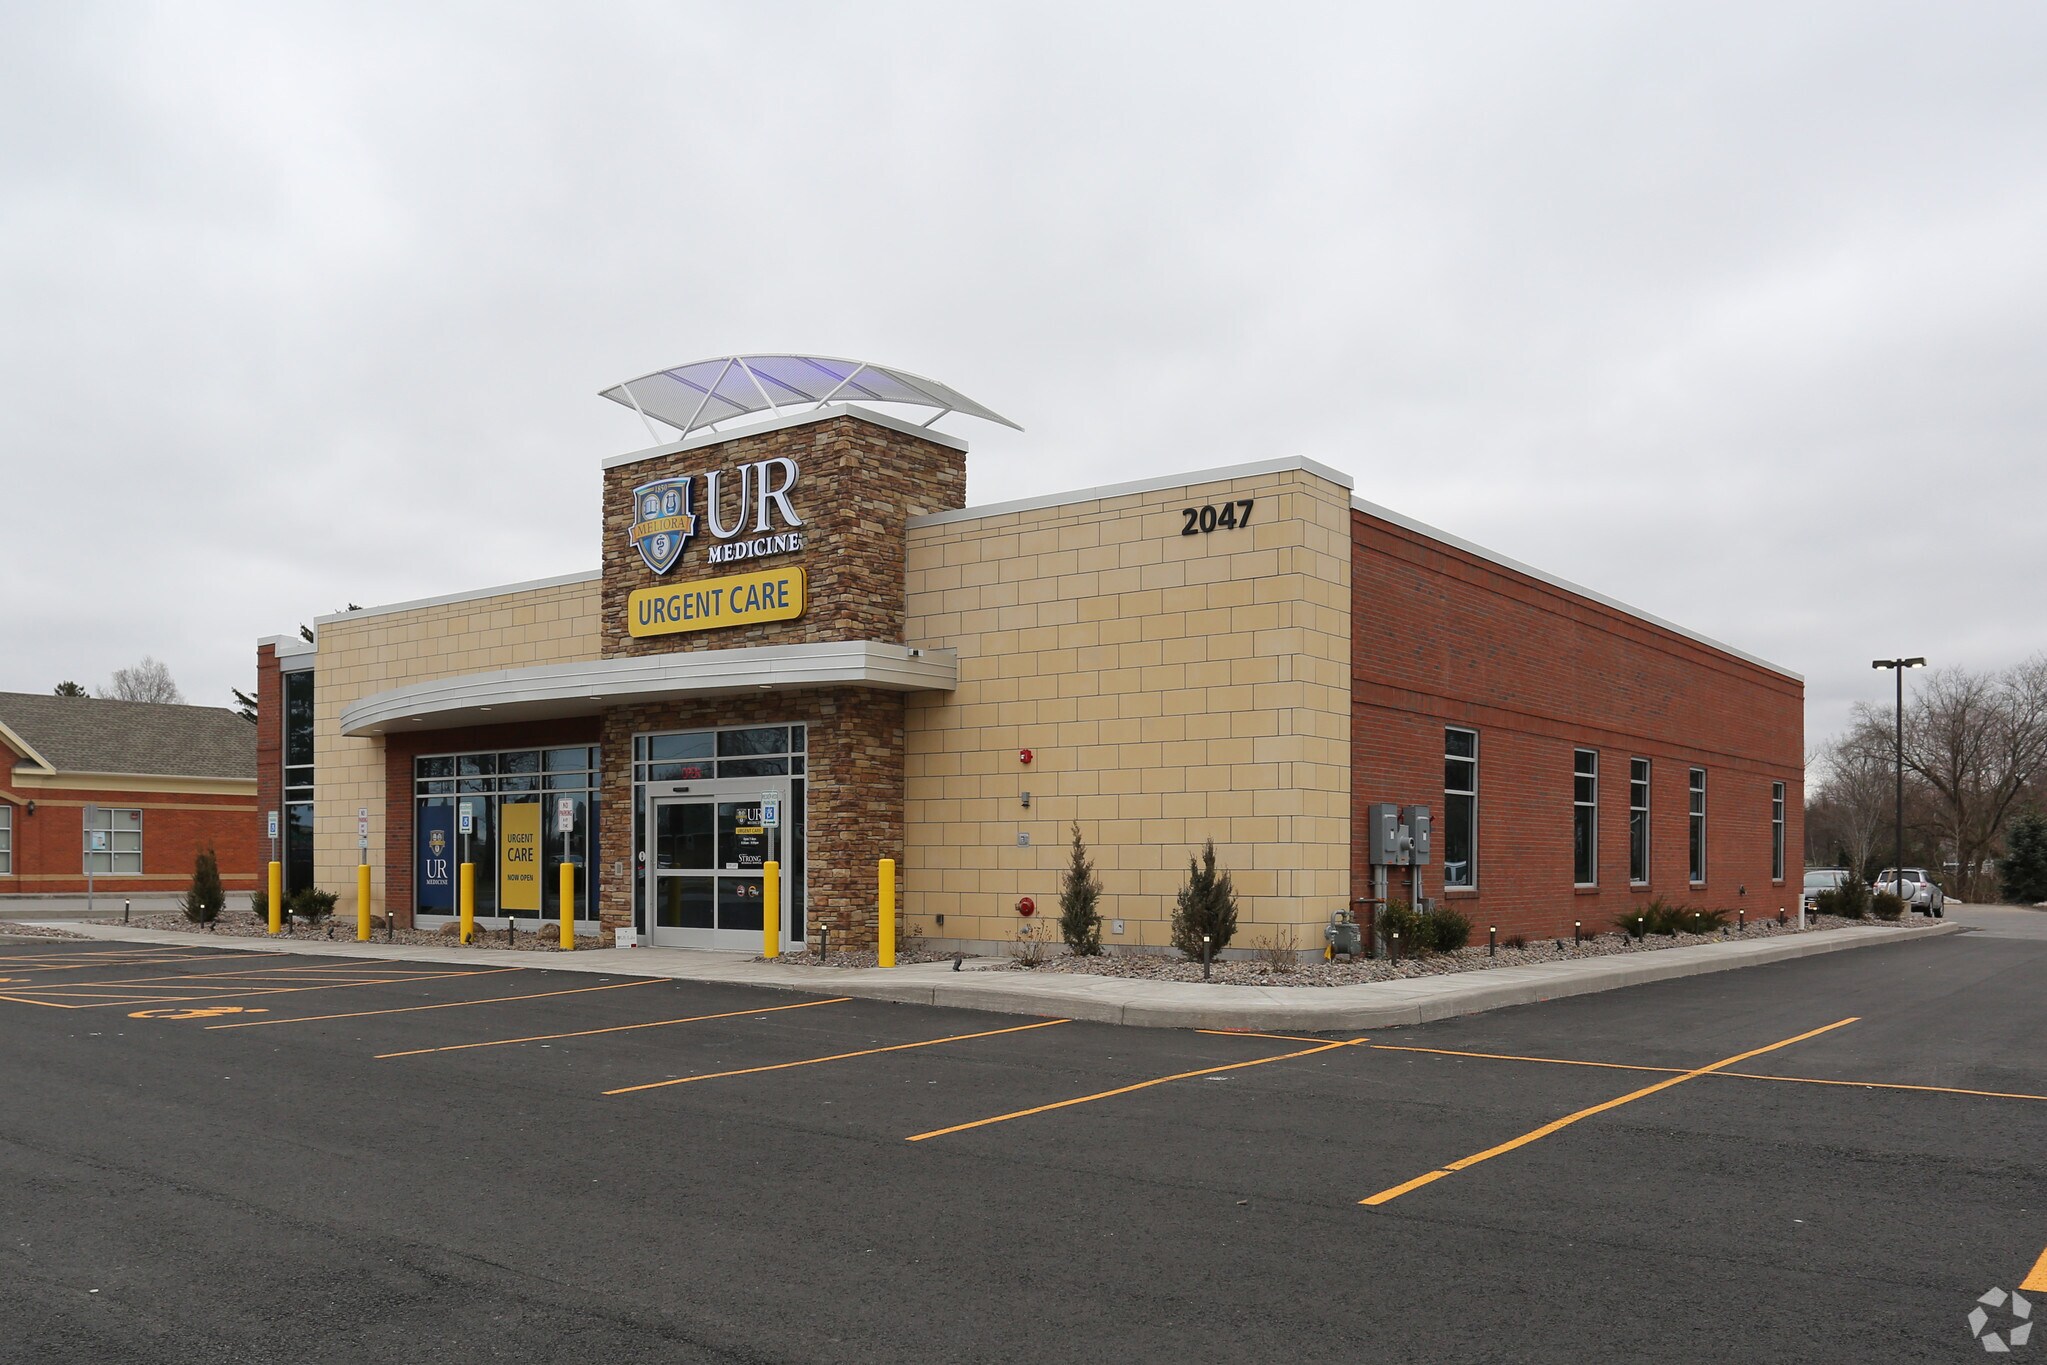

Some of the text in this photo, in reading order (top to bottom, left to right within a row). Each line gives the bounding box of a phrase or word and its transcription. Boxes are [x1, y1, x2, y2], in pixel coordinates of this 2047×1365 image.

[704, 457, 805, 538] UR
[637, 517, 685, 536] MELIORA
[1182, 499, 1254, 536] 2047
[707, 532, 801, 564] MEDICINE
[639, 579, 789, 625] URGENT CARE
[747, 809, 762, 821] UR
[507, 834, 533, 843] URGENT
[507, 847, 533, 862] CARE
[426, 859, 448, 879] UR
